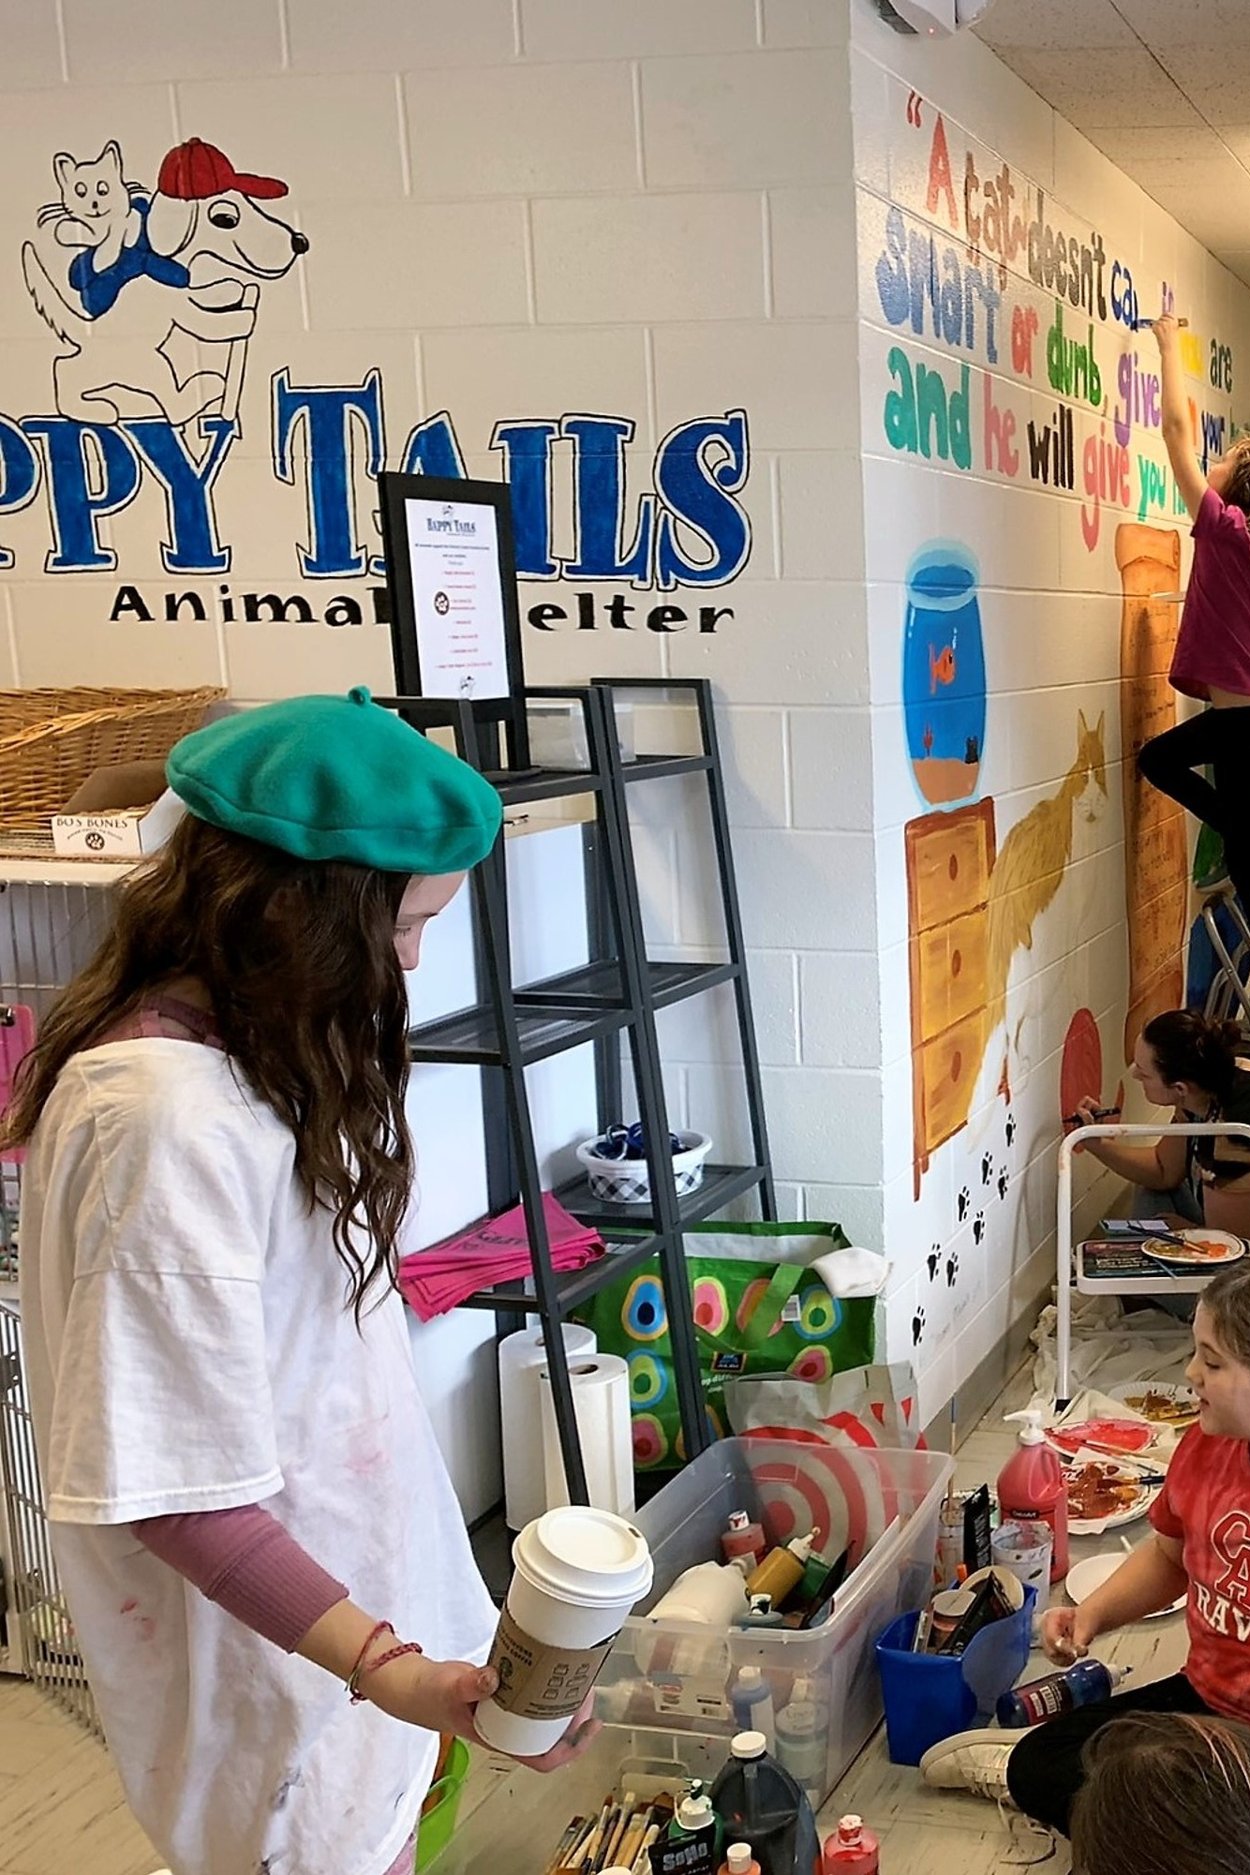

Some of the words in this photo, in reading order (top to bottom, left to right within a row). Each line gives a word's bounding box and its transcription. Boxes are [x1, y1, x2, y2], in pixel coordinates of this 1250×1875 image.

[1011, 304, 1039, 379] or
[1114, 350, 1161, 449] give
[1210, 338, 1232, 393] are
[884, 346, 972, 470] and
[983, 373, 1019, 477] he
[1027, 403, 1074, 490] will
[1082, 423, 1129, 553] give
[1138, 455, 1166, 522] you
[427, 518, 452, 532] HAPPY
[87, 819, 128, 829] BONES
